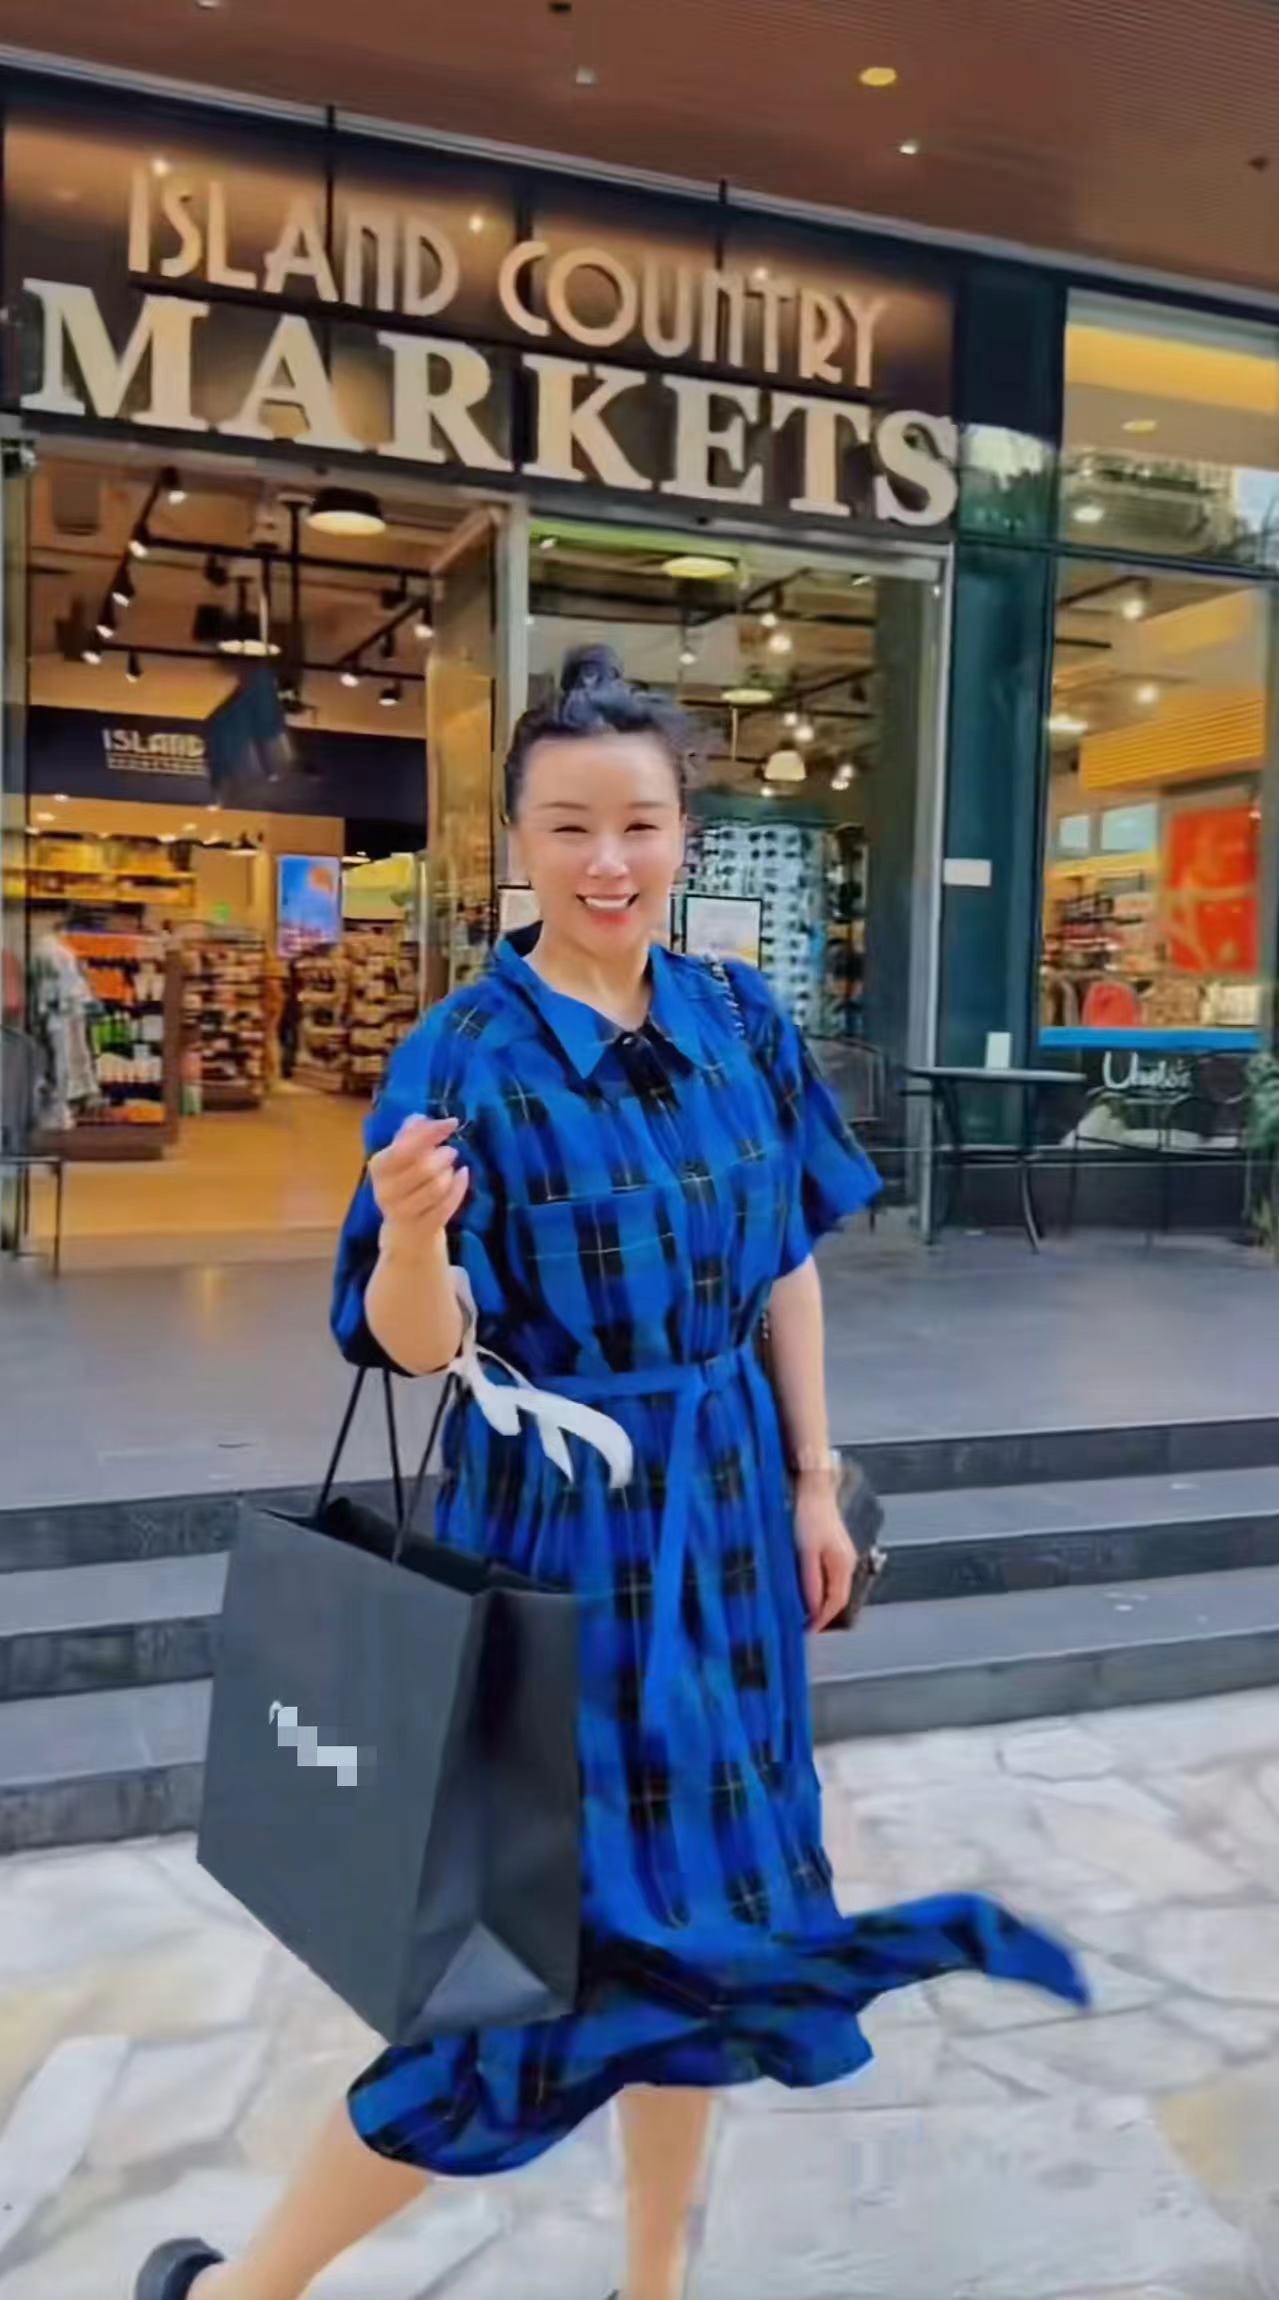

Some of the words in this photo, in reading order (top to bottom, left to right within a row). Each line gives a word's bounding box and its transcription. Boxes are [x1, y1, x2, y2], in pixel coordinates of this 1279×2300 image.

[127, 167, 460, 317] ISLAND
[499, 240, 890, 389] COUNTRY
[20, 277, 959, 527] MARKETS
